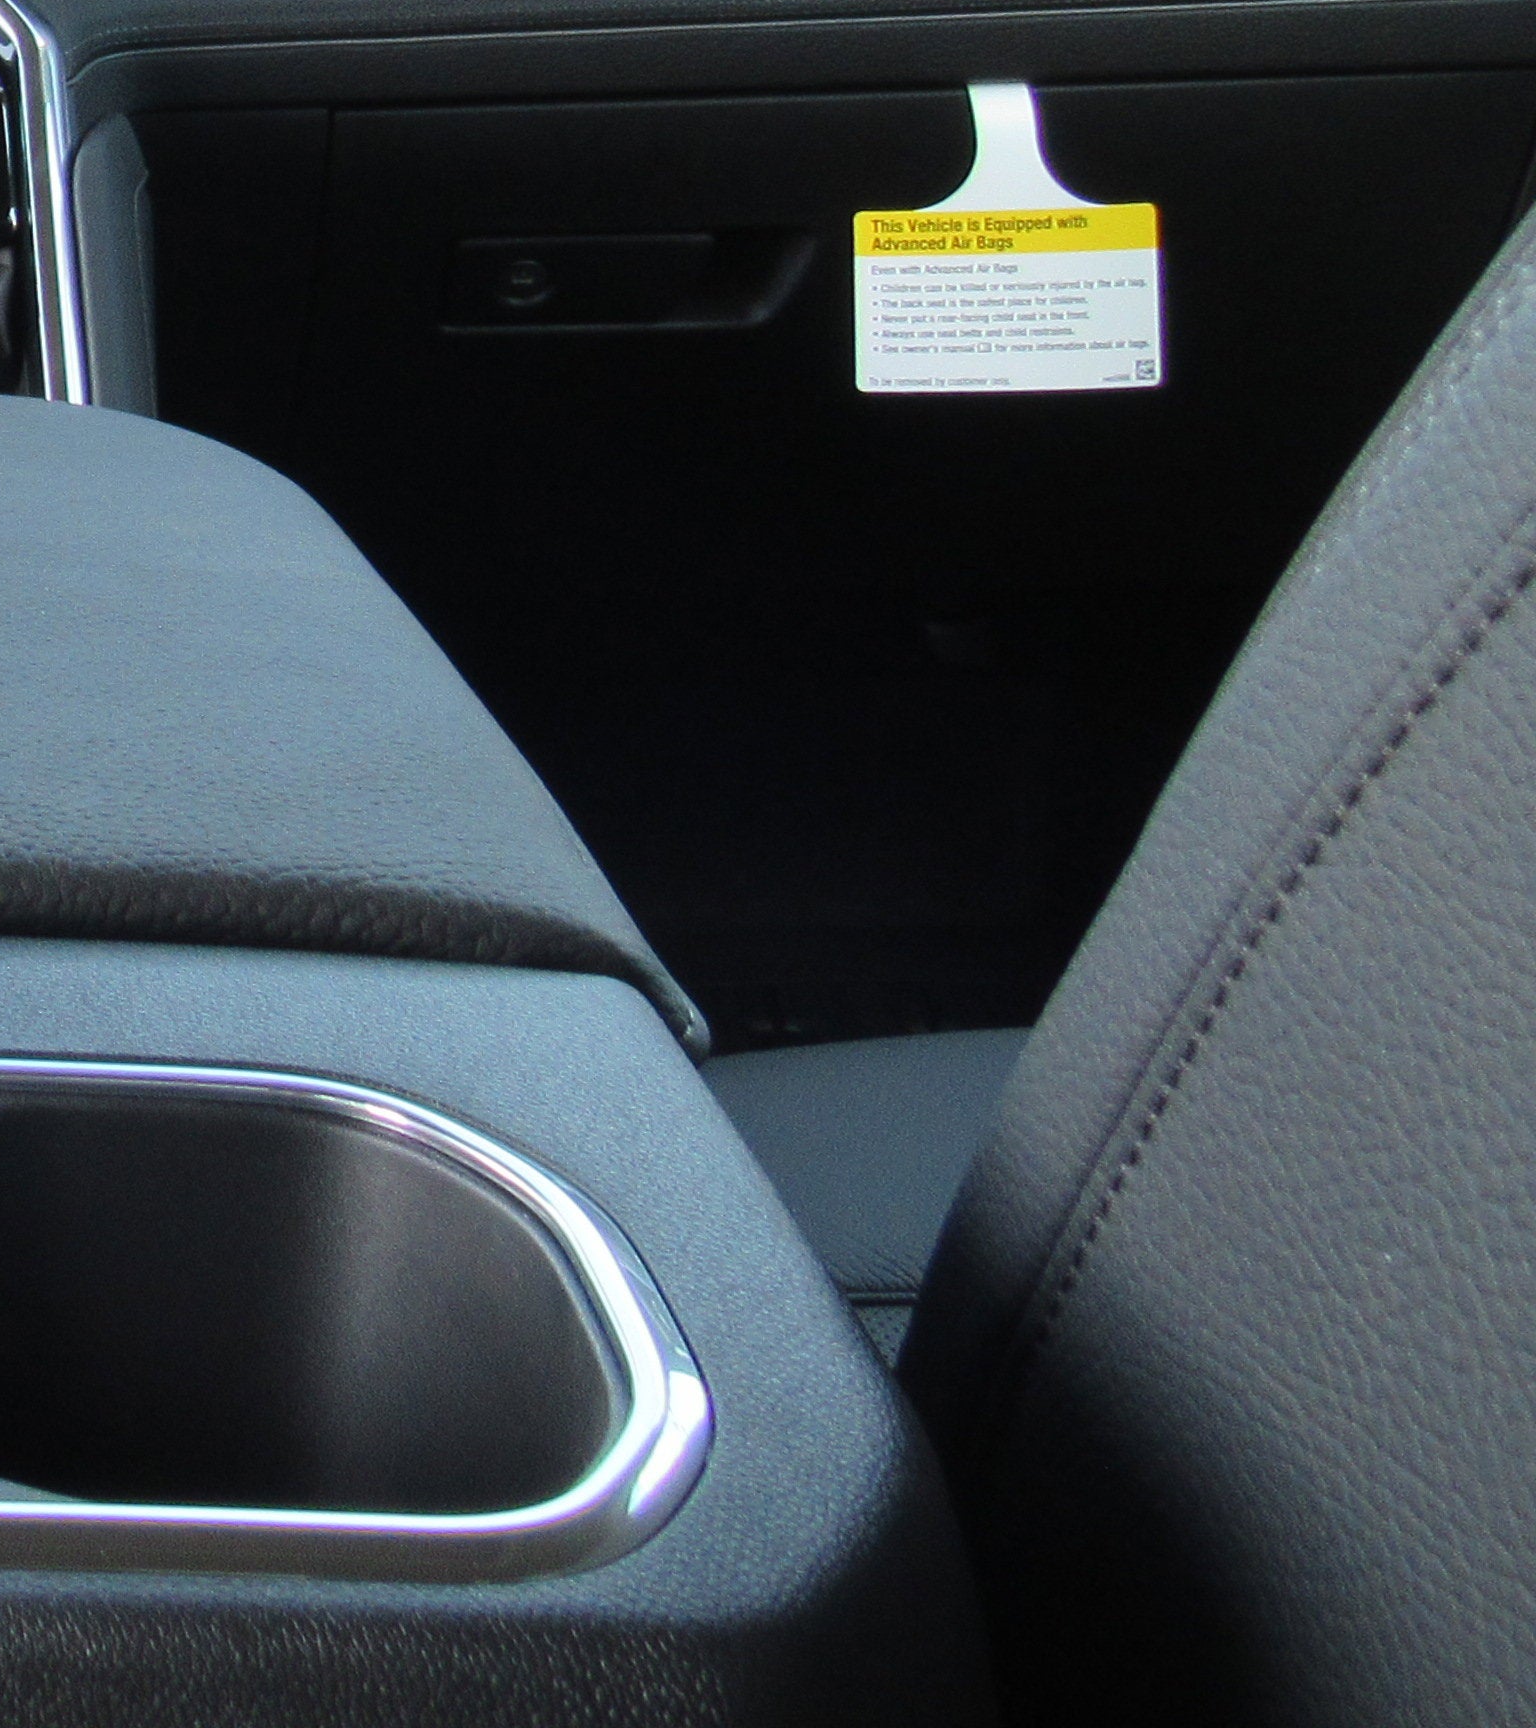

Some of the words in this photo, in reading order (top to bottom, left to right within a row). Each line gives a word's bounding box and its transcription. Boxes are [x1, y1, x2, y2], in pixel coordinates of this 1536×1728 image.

[871, 218, 903, 233] This
[907, 217, 962, 232] Vehicle
[967, 217, 979, 232] is
[984, 215, 1052, 234] Equipped
[1056, 215, 1088, 229] with
[872, 235, 946, 251] Advanced
[951, 235, 971, 249] Air
[976, 235, 1013, 251] Bags
